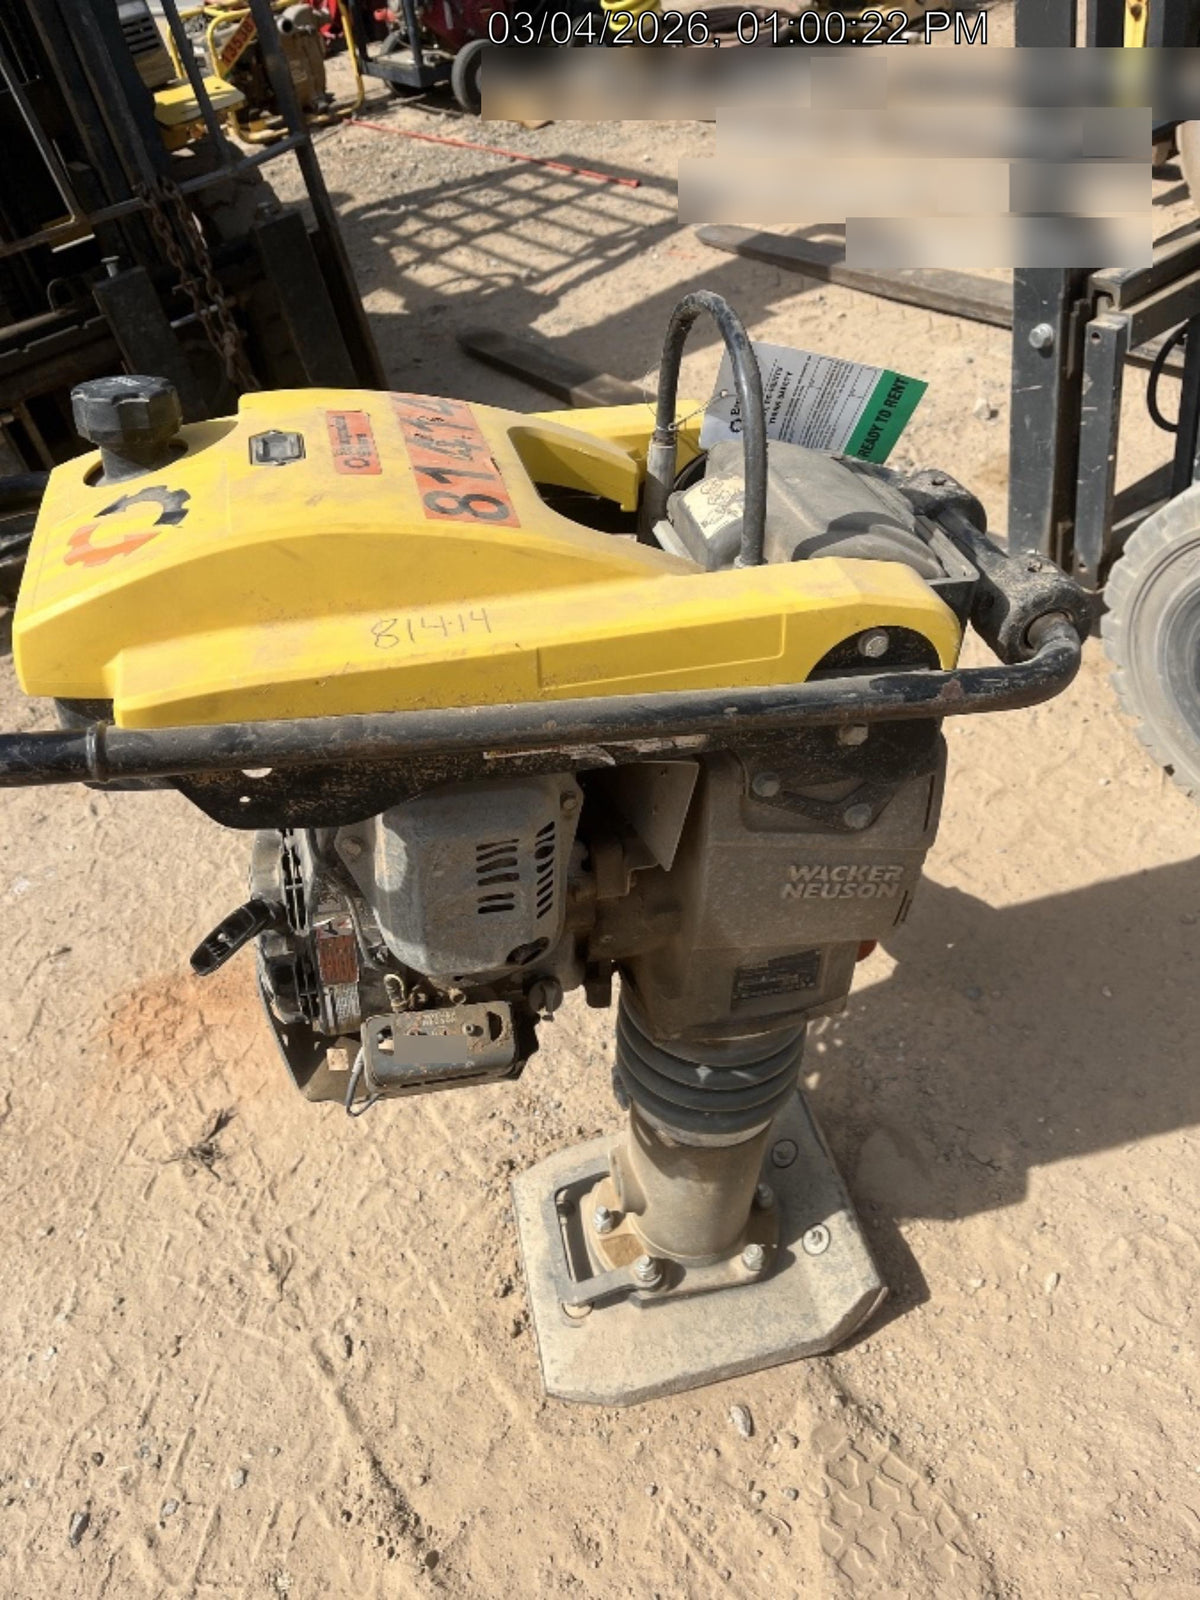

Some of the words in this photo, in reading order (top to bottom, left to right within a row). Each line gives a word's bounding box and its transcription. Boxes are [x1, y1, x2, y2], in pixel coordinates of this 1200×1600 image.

[857, 423, 885, 457] READY
[875, 409, 892, 422] TO
[884, 376, 910, 407] RENT
[390, 394, 510, 521] 81414
[370, 607, 492, 649] 81414
[781, 882, 901, 899] NEUSON
[790, 864, 904, 881] WACKER
